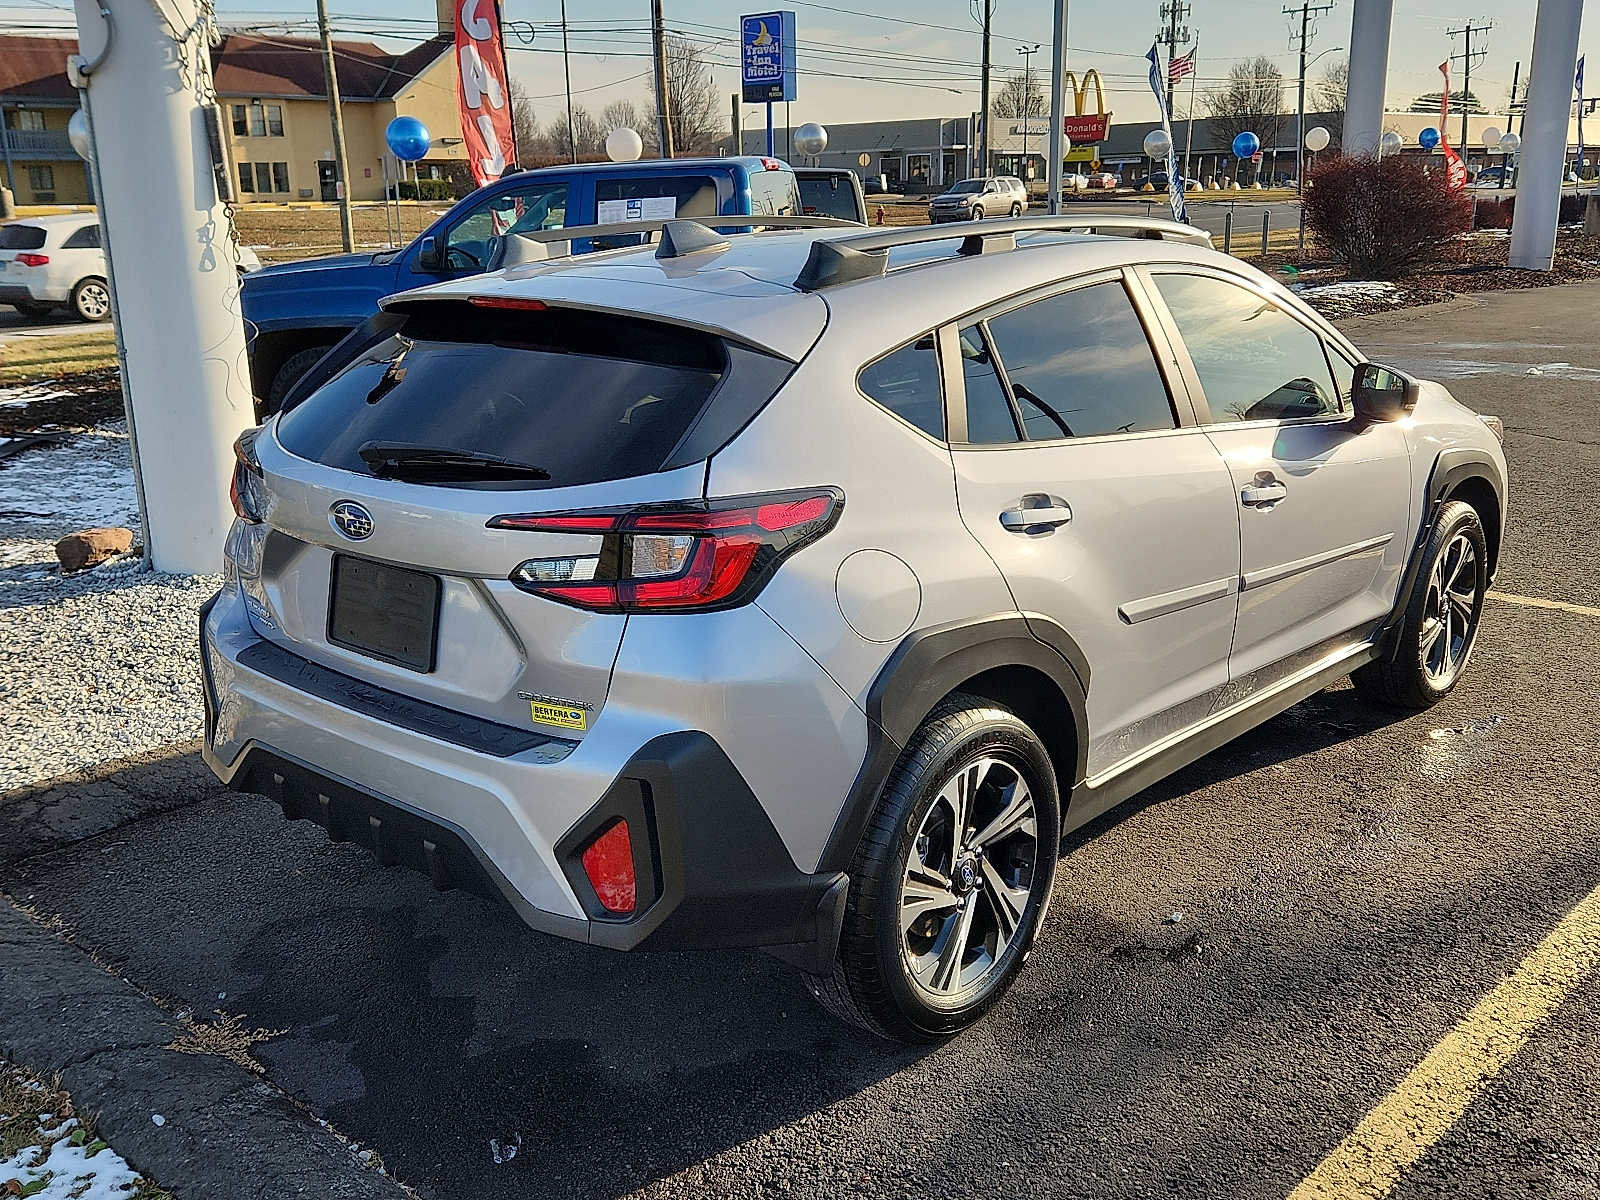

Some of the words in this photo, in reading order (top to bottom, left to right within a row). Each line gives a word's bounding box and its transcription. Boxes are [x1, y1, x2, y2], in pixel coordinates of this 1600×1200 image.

[745, 42, 780, 56] Travel
[752, 55, 772, 65] Inn
[747, 65, 778, 78] Motel
[533, 705, 569, 719] BERTERA
